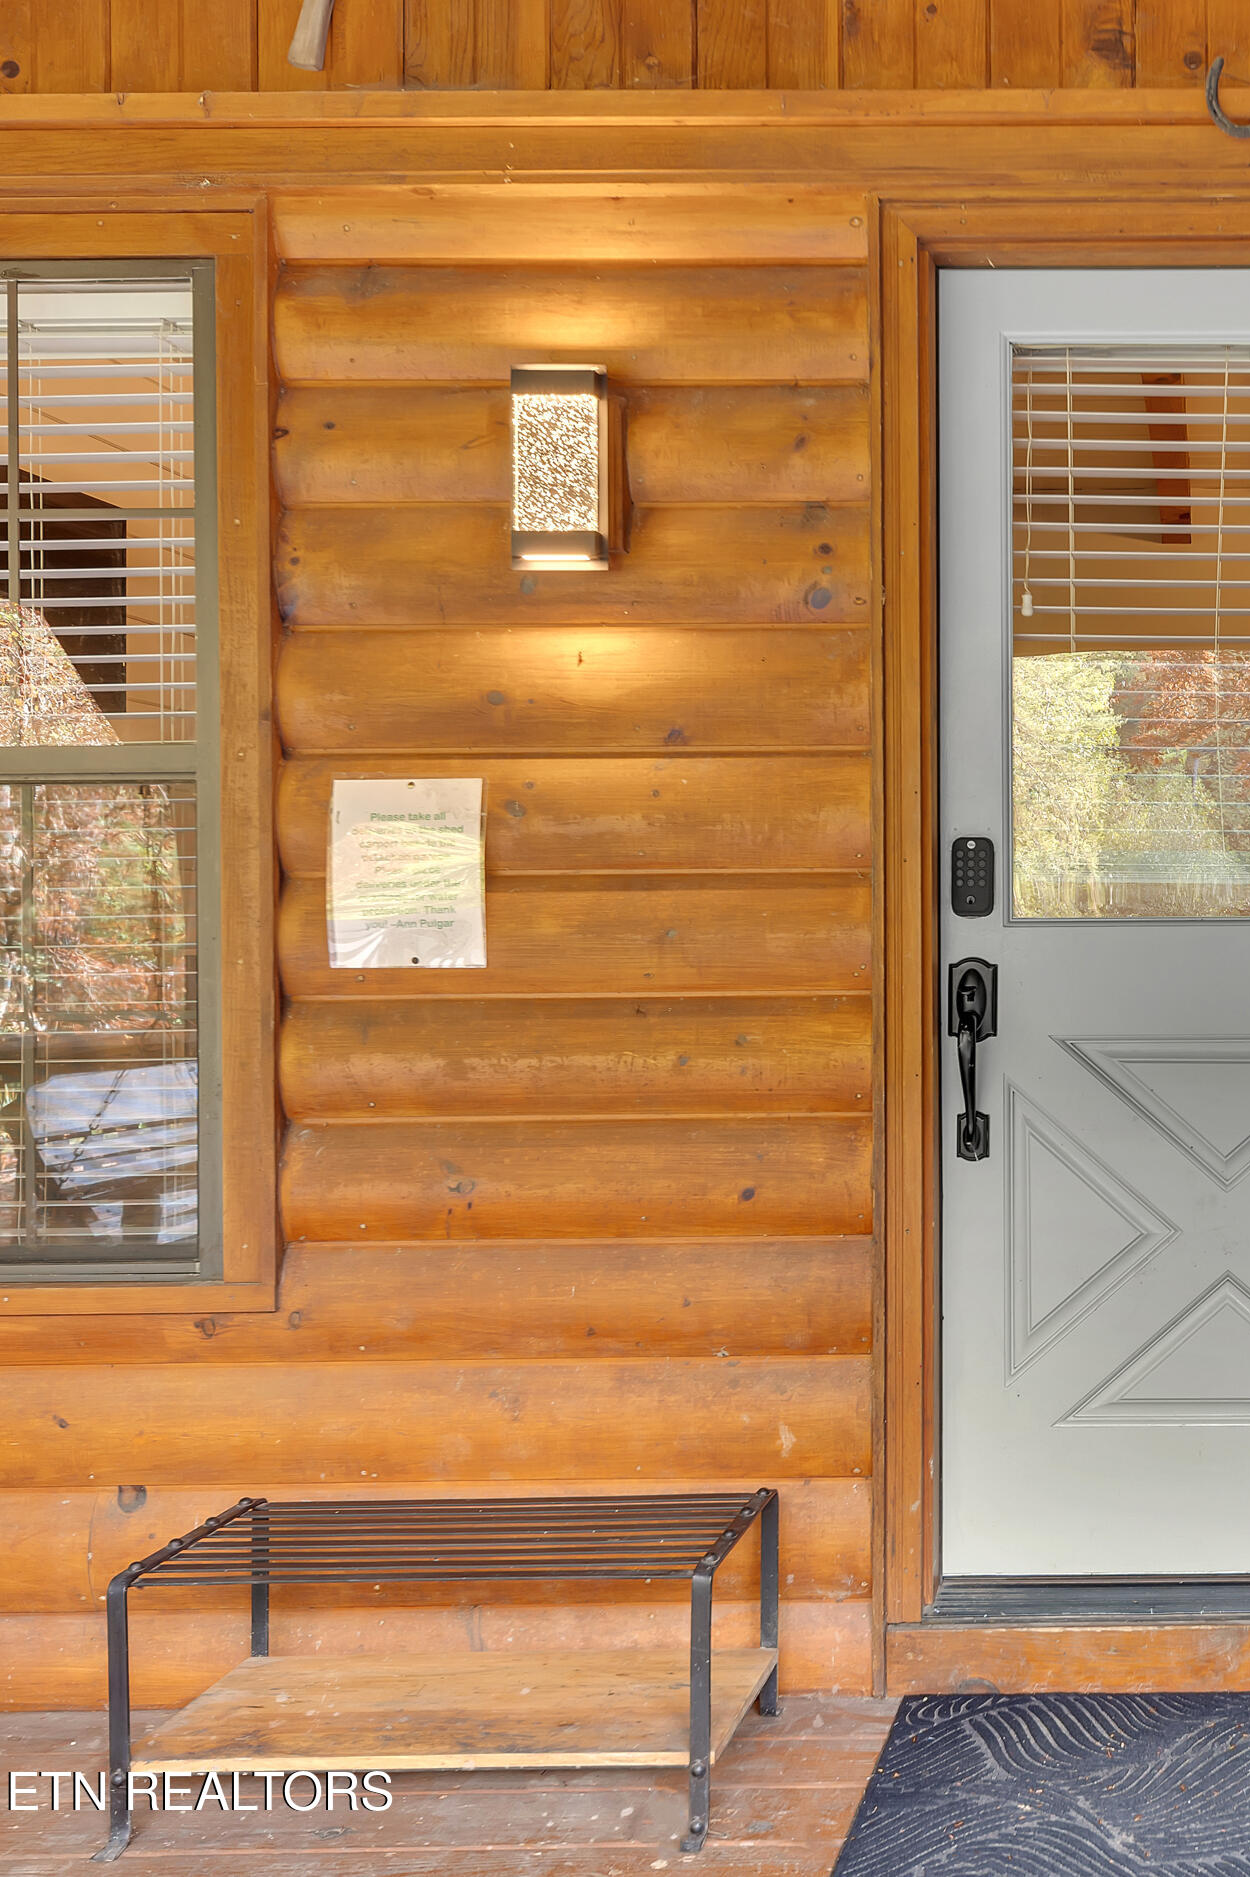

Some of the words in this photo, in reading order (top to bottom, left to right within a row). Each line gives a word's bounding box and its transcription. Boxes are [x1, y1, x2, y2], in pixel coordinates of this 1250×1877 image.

[370, 812, 405, 821] Please
[408, 812, 431, 821] take
[434, 811, 446, 821] all
[424, 905, 456, 915] Thank
